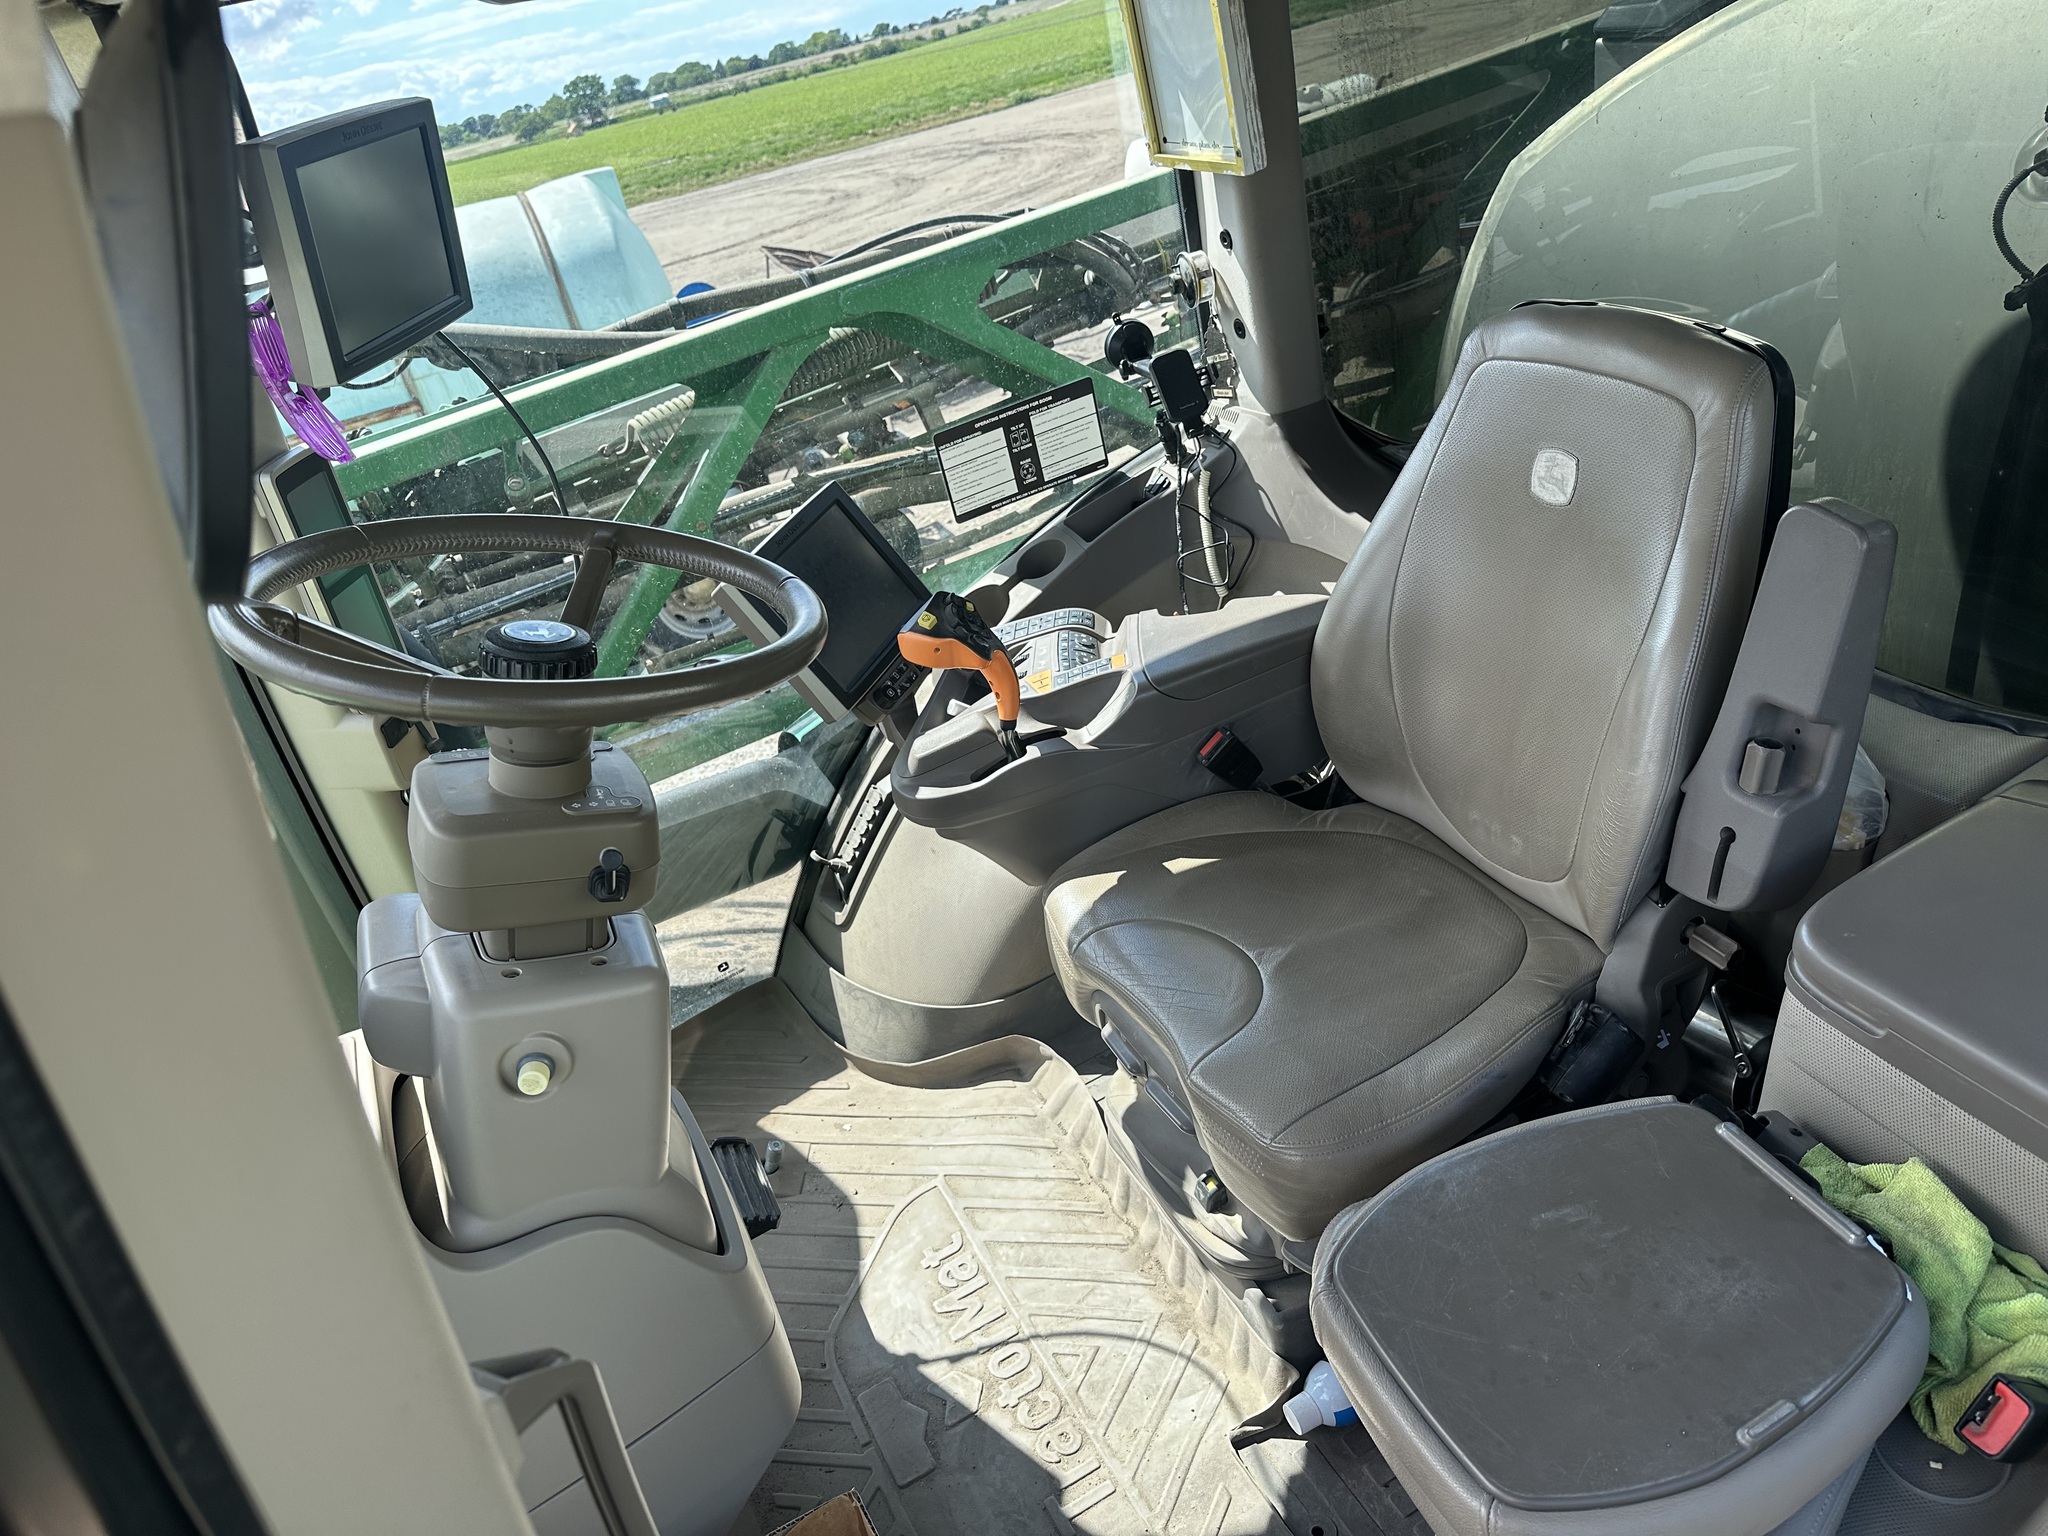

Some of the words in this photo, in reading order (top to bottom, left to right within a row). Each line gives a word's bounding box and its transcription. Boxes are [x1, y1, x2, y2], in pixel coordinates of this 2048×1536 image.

[342, 129, 360, 142] JOHN
[361, 121, 384, 136] DEERE
[974, 415, 999, 429] OPERATING
[999, 404, 1030, 420] INSTRUCTIONS
[1029, 401, 1039, 409] FOR
[1039, 396, 1053, 405] BOOM
[938, 441, 954, 451] UNFOLD
[1020, 442, 1033, 451] DOWN
[1019, 457, 1032, 466] RAISE
[1023, 476, 1037, 485] LOWER
[775, 533, 789, 548] JOHN
[788, 518, 805, 536] DEERE
[920, 1231, 1117, 1536] TractorMat
